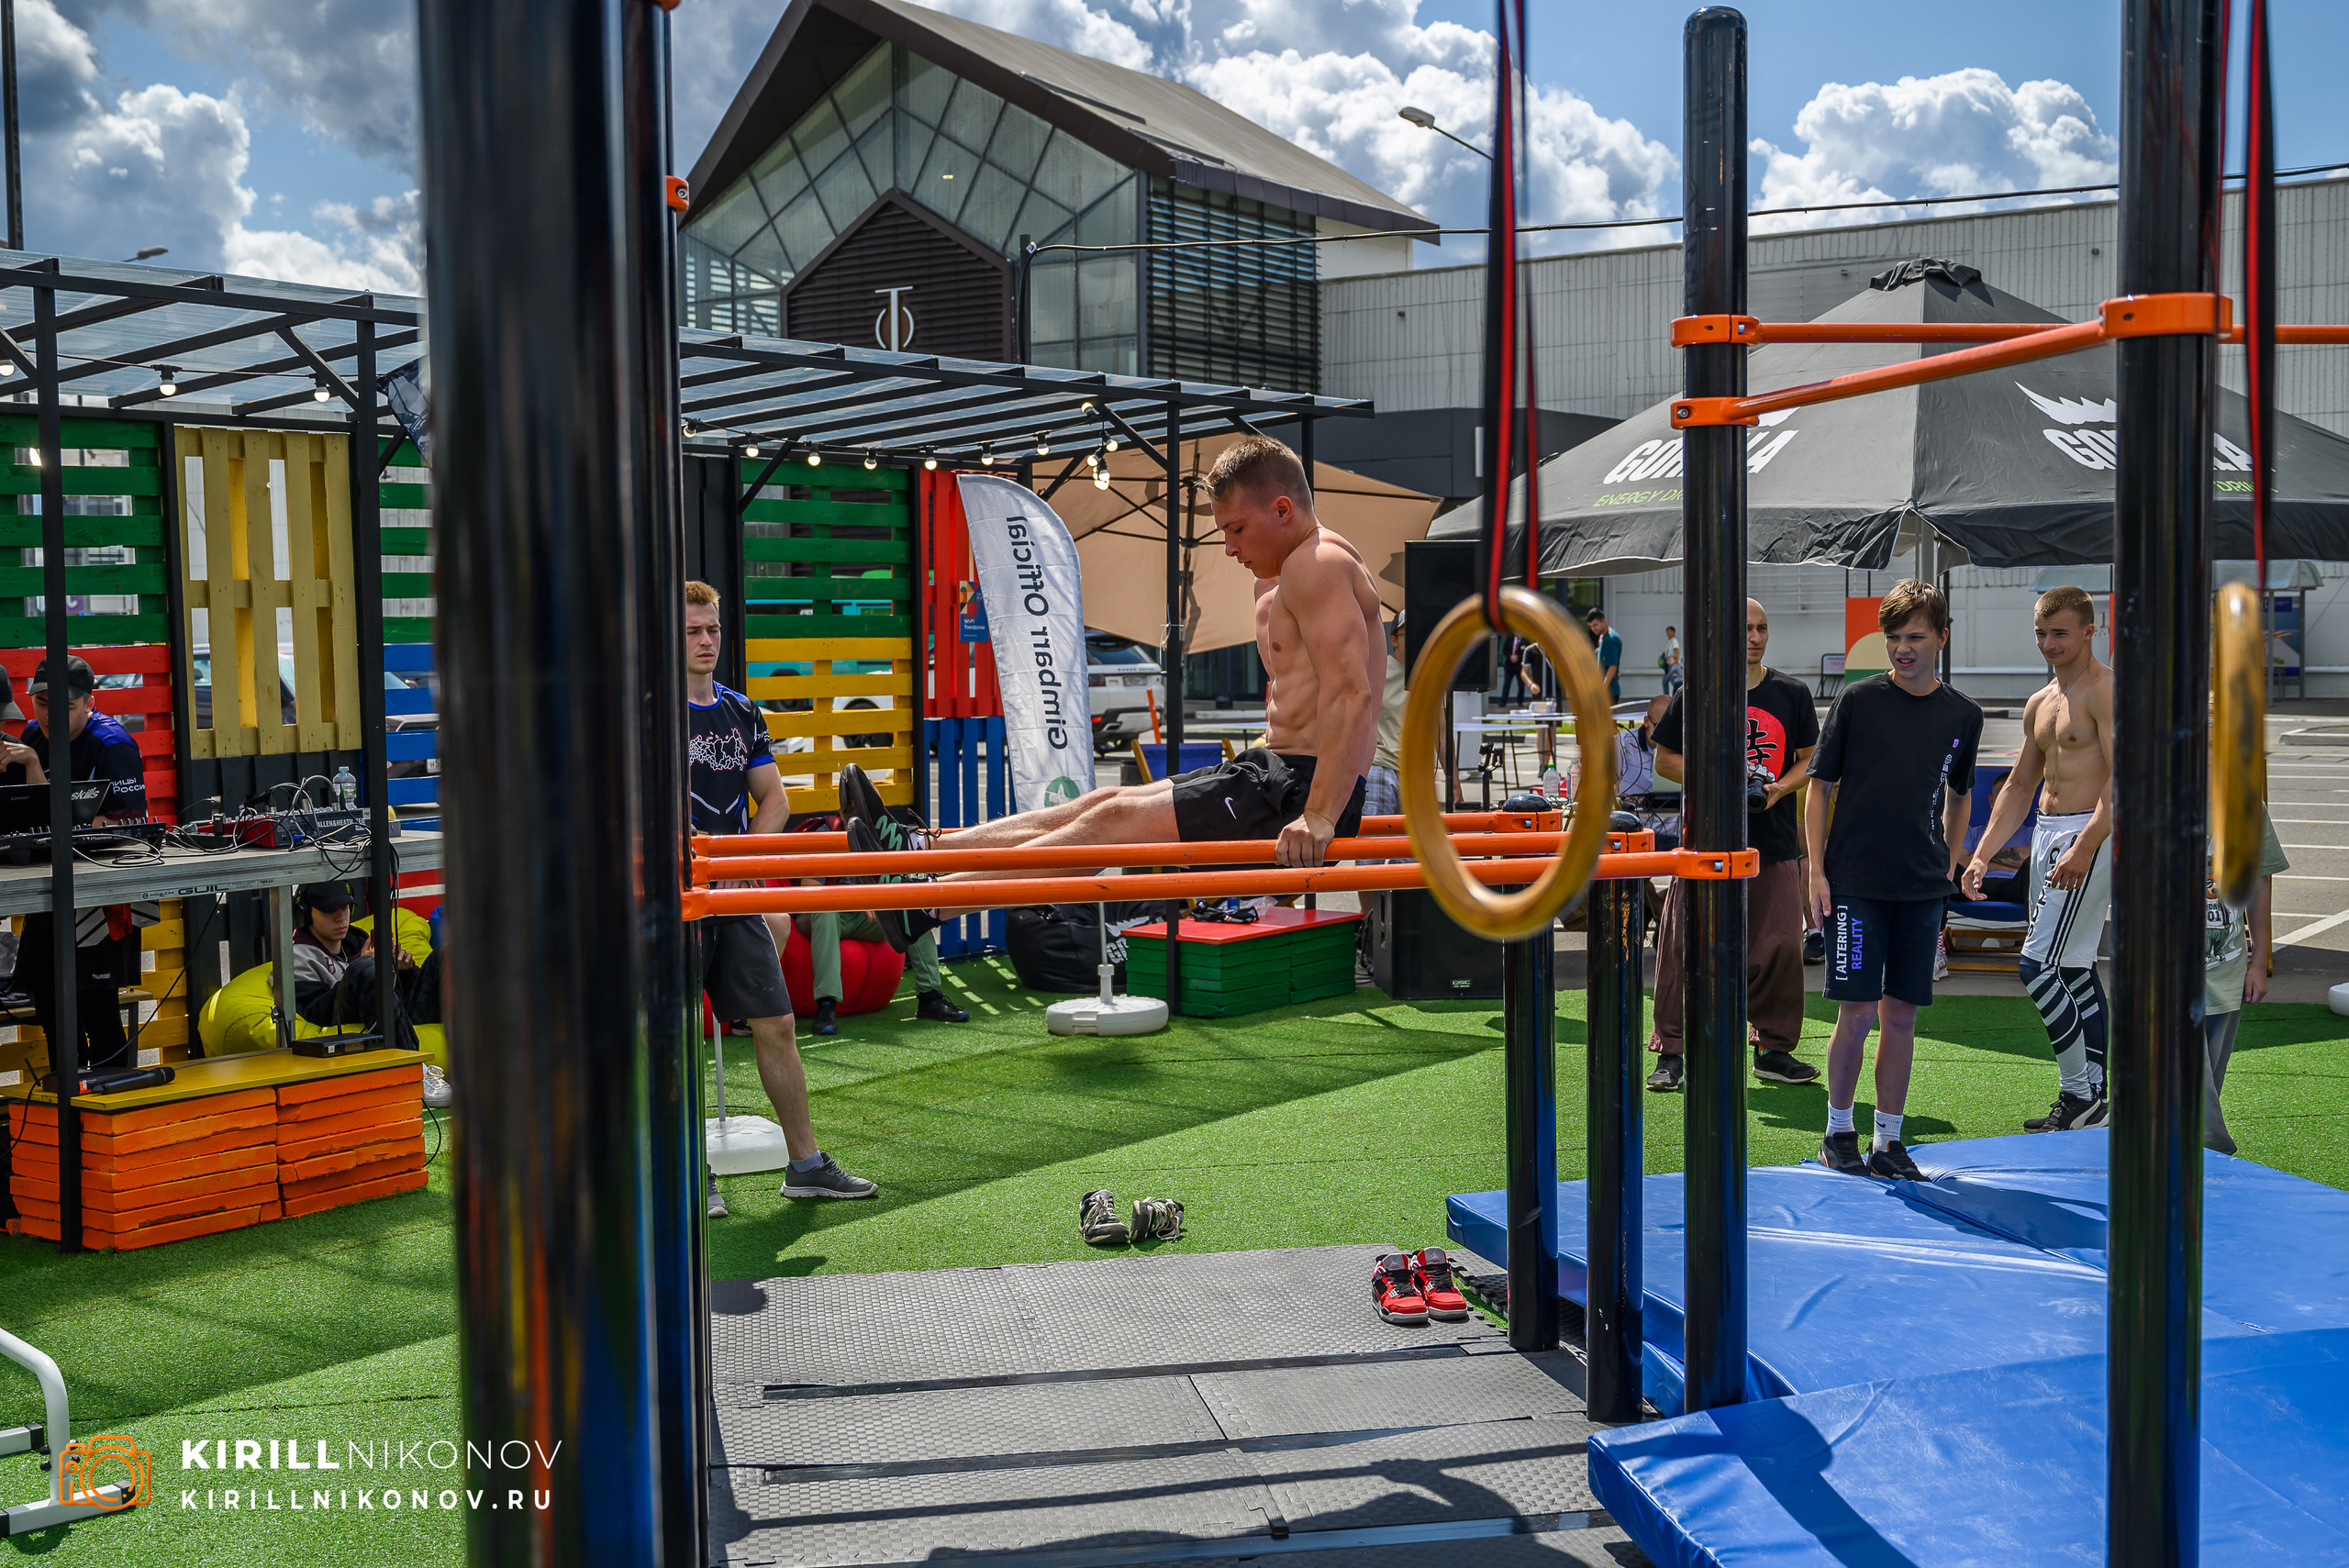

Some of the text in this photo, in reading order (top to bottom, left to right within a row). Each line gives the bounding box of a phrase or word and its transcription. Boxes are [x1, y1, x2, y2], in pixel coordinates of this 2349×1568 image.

[1592, 489, 1664, 506] ENERGY
[113, 784, 146, 794] Росси
[317, 818, 353, 828] ALLEN&HEATH
[178, 884, 228, 895] GUIL
[1851, 917, 1863, 969] REALITY
